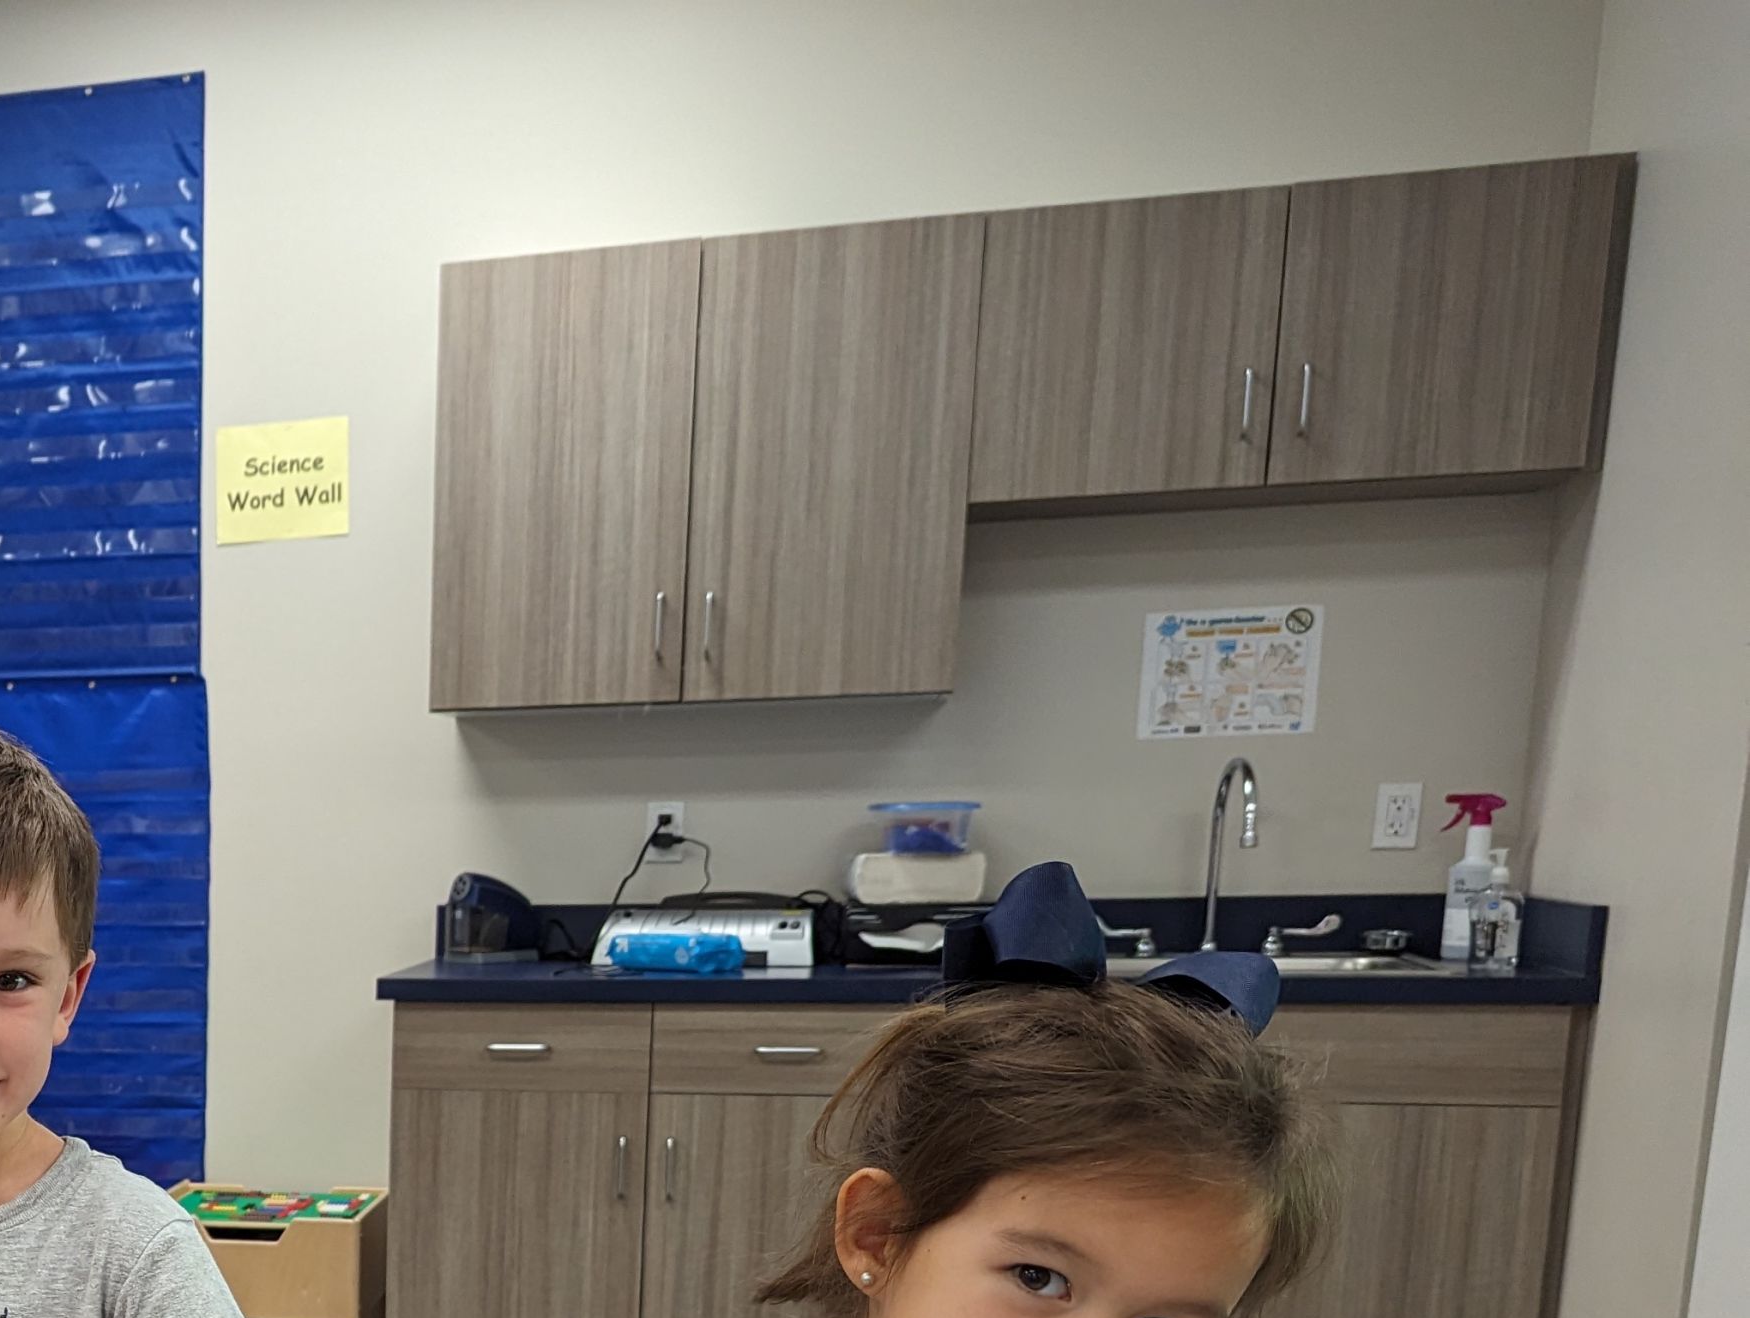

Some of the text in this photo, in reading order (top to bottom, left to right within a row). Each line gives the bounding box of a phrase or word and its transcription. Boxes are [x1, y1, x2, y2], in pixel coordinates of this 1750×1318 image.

[244, 455, 325, 477] Science
[227, 482, 343, 512] Word Wall
